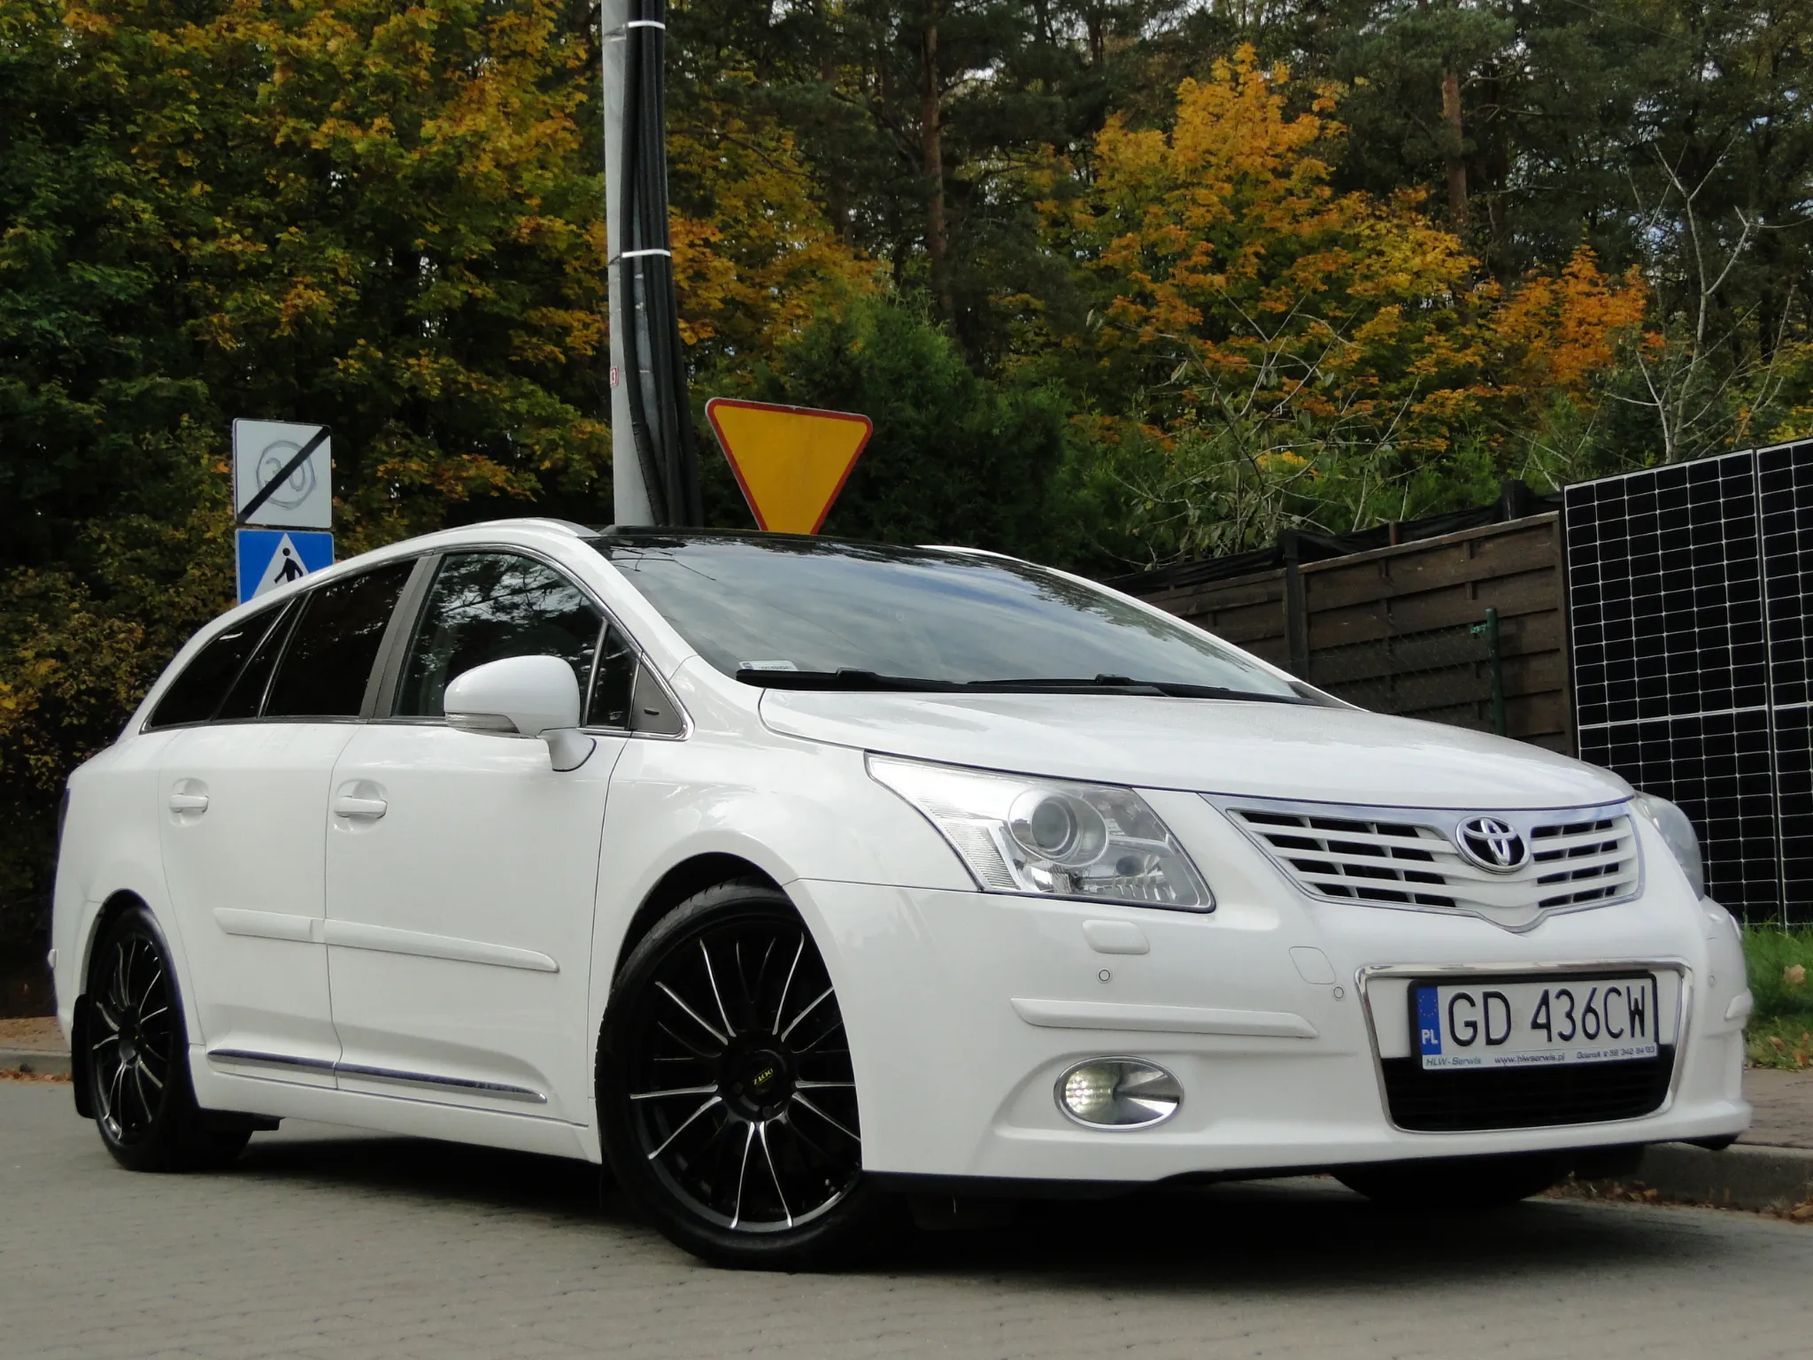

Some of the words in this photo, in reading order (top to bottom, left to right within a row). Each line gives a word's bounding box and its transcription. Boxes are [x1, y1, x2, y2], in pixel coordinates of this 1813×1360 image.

[1448, 990, 1512, 1047] GD
[1530, 985, 1646, 1042] 436CW
[1421, 1029, 1438, 1045] PL
